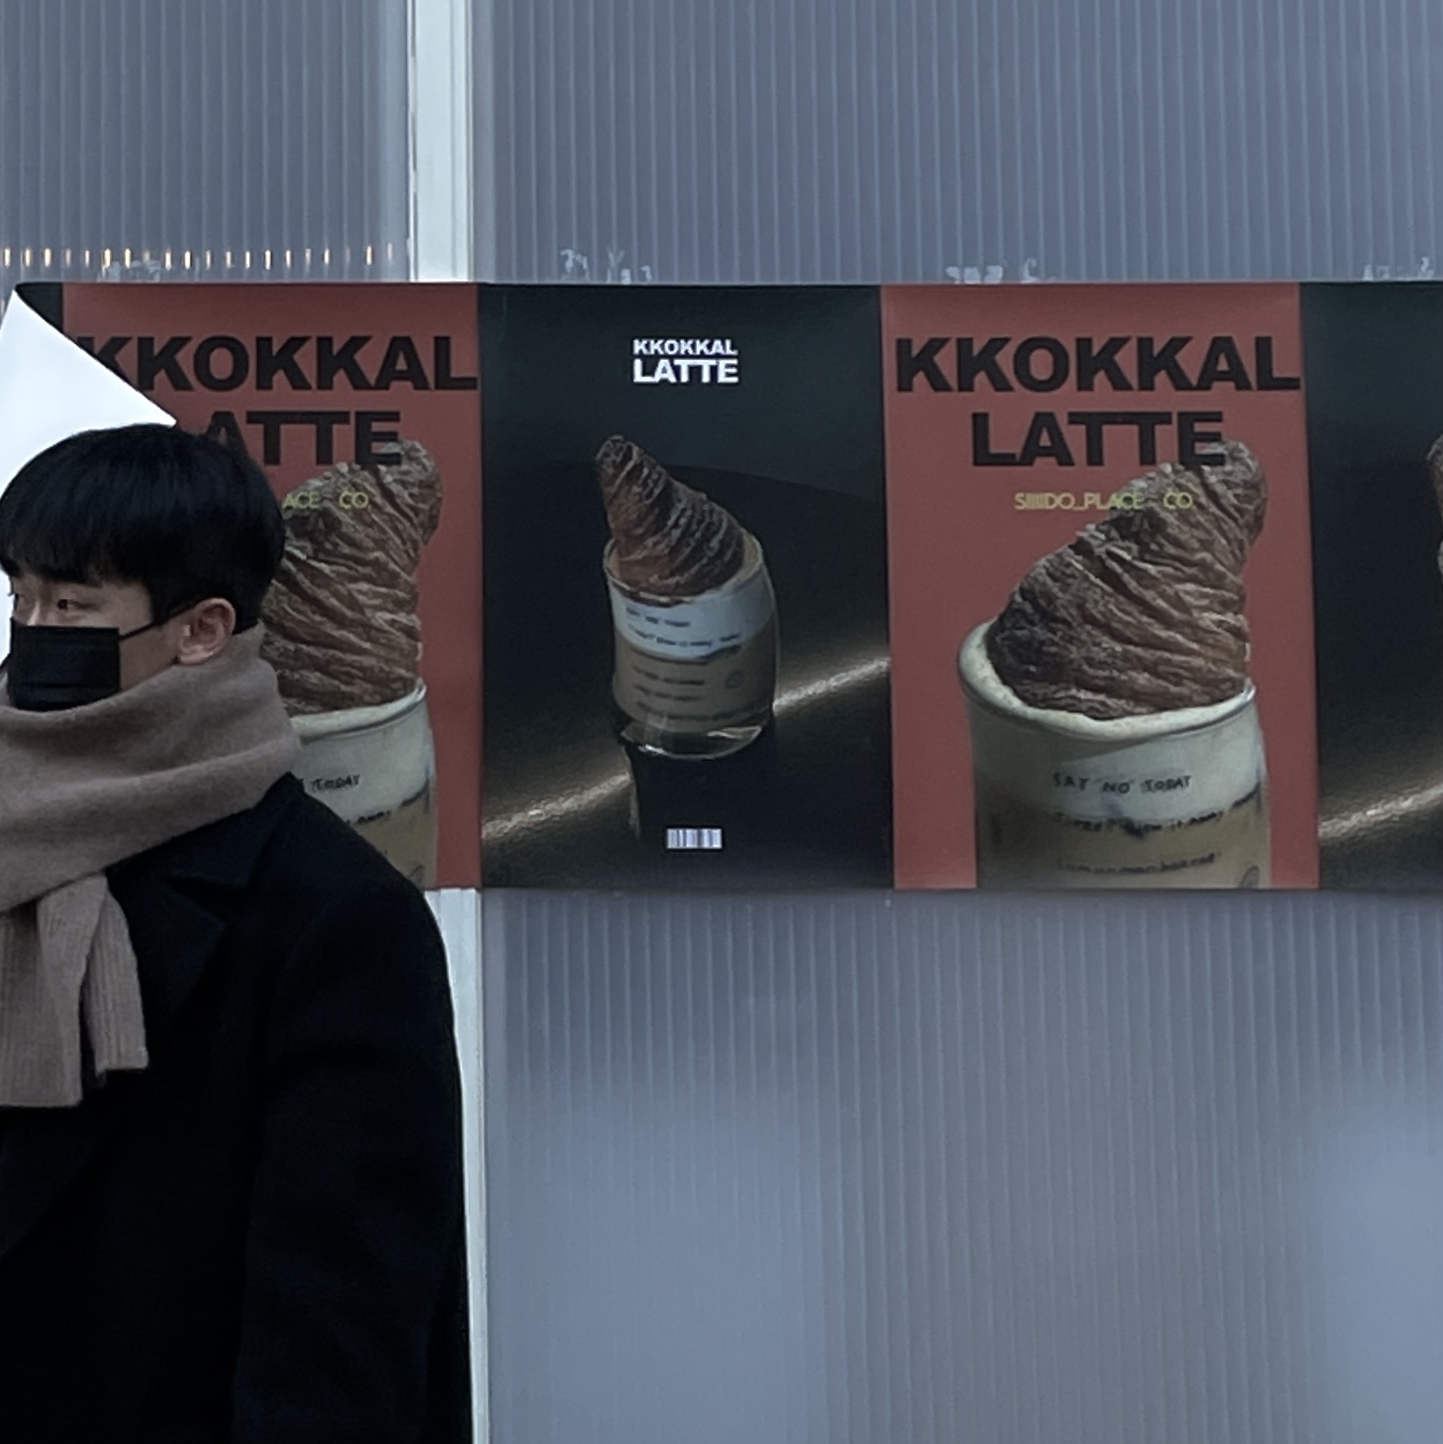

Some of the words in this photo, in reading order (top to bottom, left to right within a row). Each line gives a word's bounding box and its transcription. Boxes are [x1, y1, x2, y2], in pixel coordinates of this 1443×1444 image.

[633, 338, 739, 356] KKOKKAL
[633, 358, 739, 383] LATTE
[895, 336, 1301, 393] KKOKKAL
[204, 410, 402, 467] ATTE
[972, 410, 1227, 467] LATTE
